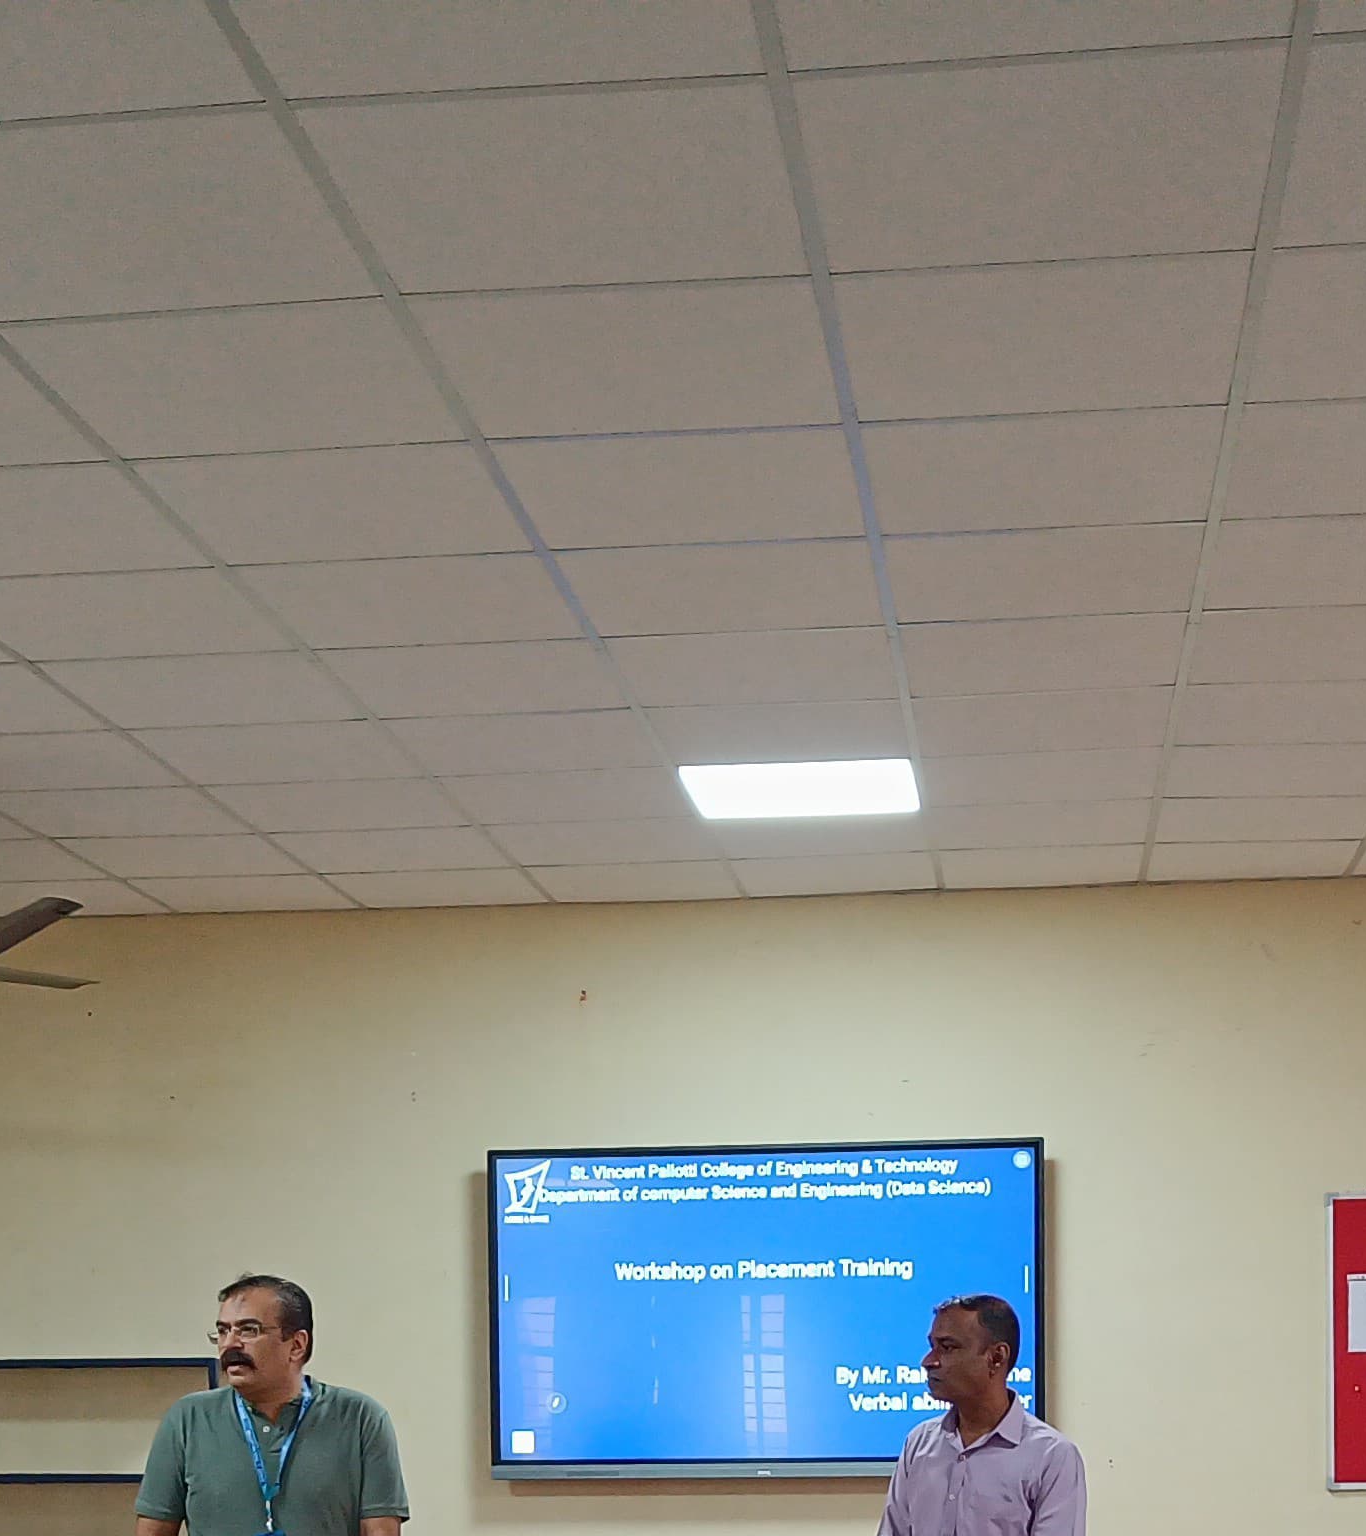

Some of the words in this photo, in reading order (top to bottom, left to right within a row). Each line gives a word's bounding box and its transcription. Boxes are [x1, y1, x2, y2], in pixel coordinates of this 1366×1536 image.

[570, 1165, 590, 1180] St.
[592, 1164, 646, 1181] Vincent
[648, 1162, 698, 1180] Pallotti
[700, 1161, 754, 1181] College
[757, 1161, 773, 1176] of
[775, 1159, 859, 1179] Engineering
[861, 1159, 873, 1175] &
[875, 1157, 958, 1177] Technology
[539, 1187, 621, 1206] Department
[623, 1186, 639, 1202] of
[641, 1187, 710, 1204] computer
[711, 1183, 767, 1200] Science
[770, 1182, 797, 1199] and
[800, 1181, 883, 1201] Engineering
[886, 1179, 926, 1199] (Data
[928, 1177, 992, 1197] Science)
[614, 1260, 706, 1283] Workshop
[710, 1263, 734, 1279] on
[737, 1259, 836, 1279] Placement
[838, 1257, 914, 1280] Training
[835, 1365, 860, 1388] By
[862, 1365, 892, 1385] Mr.
[848, 1391, 907, 1412] Verbal
